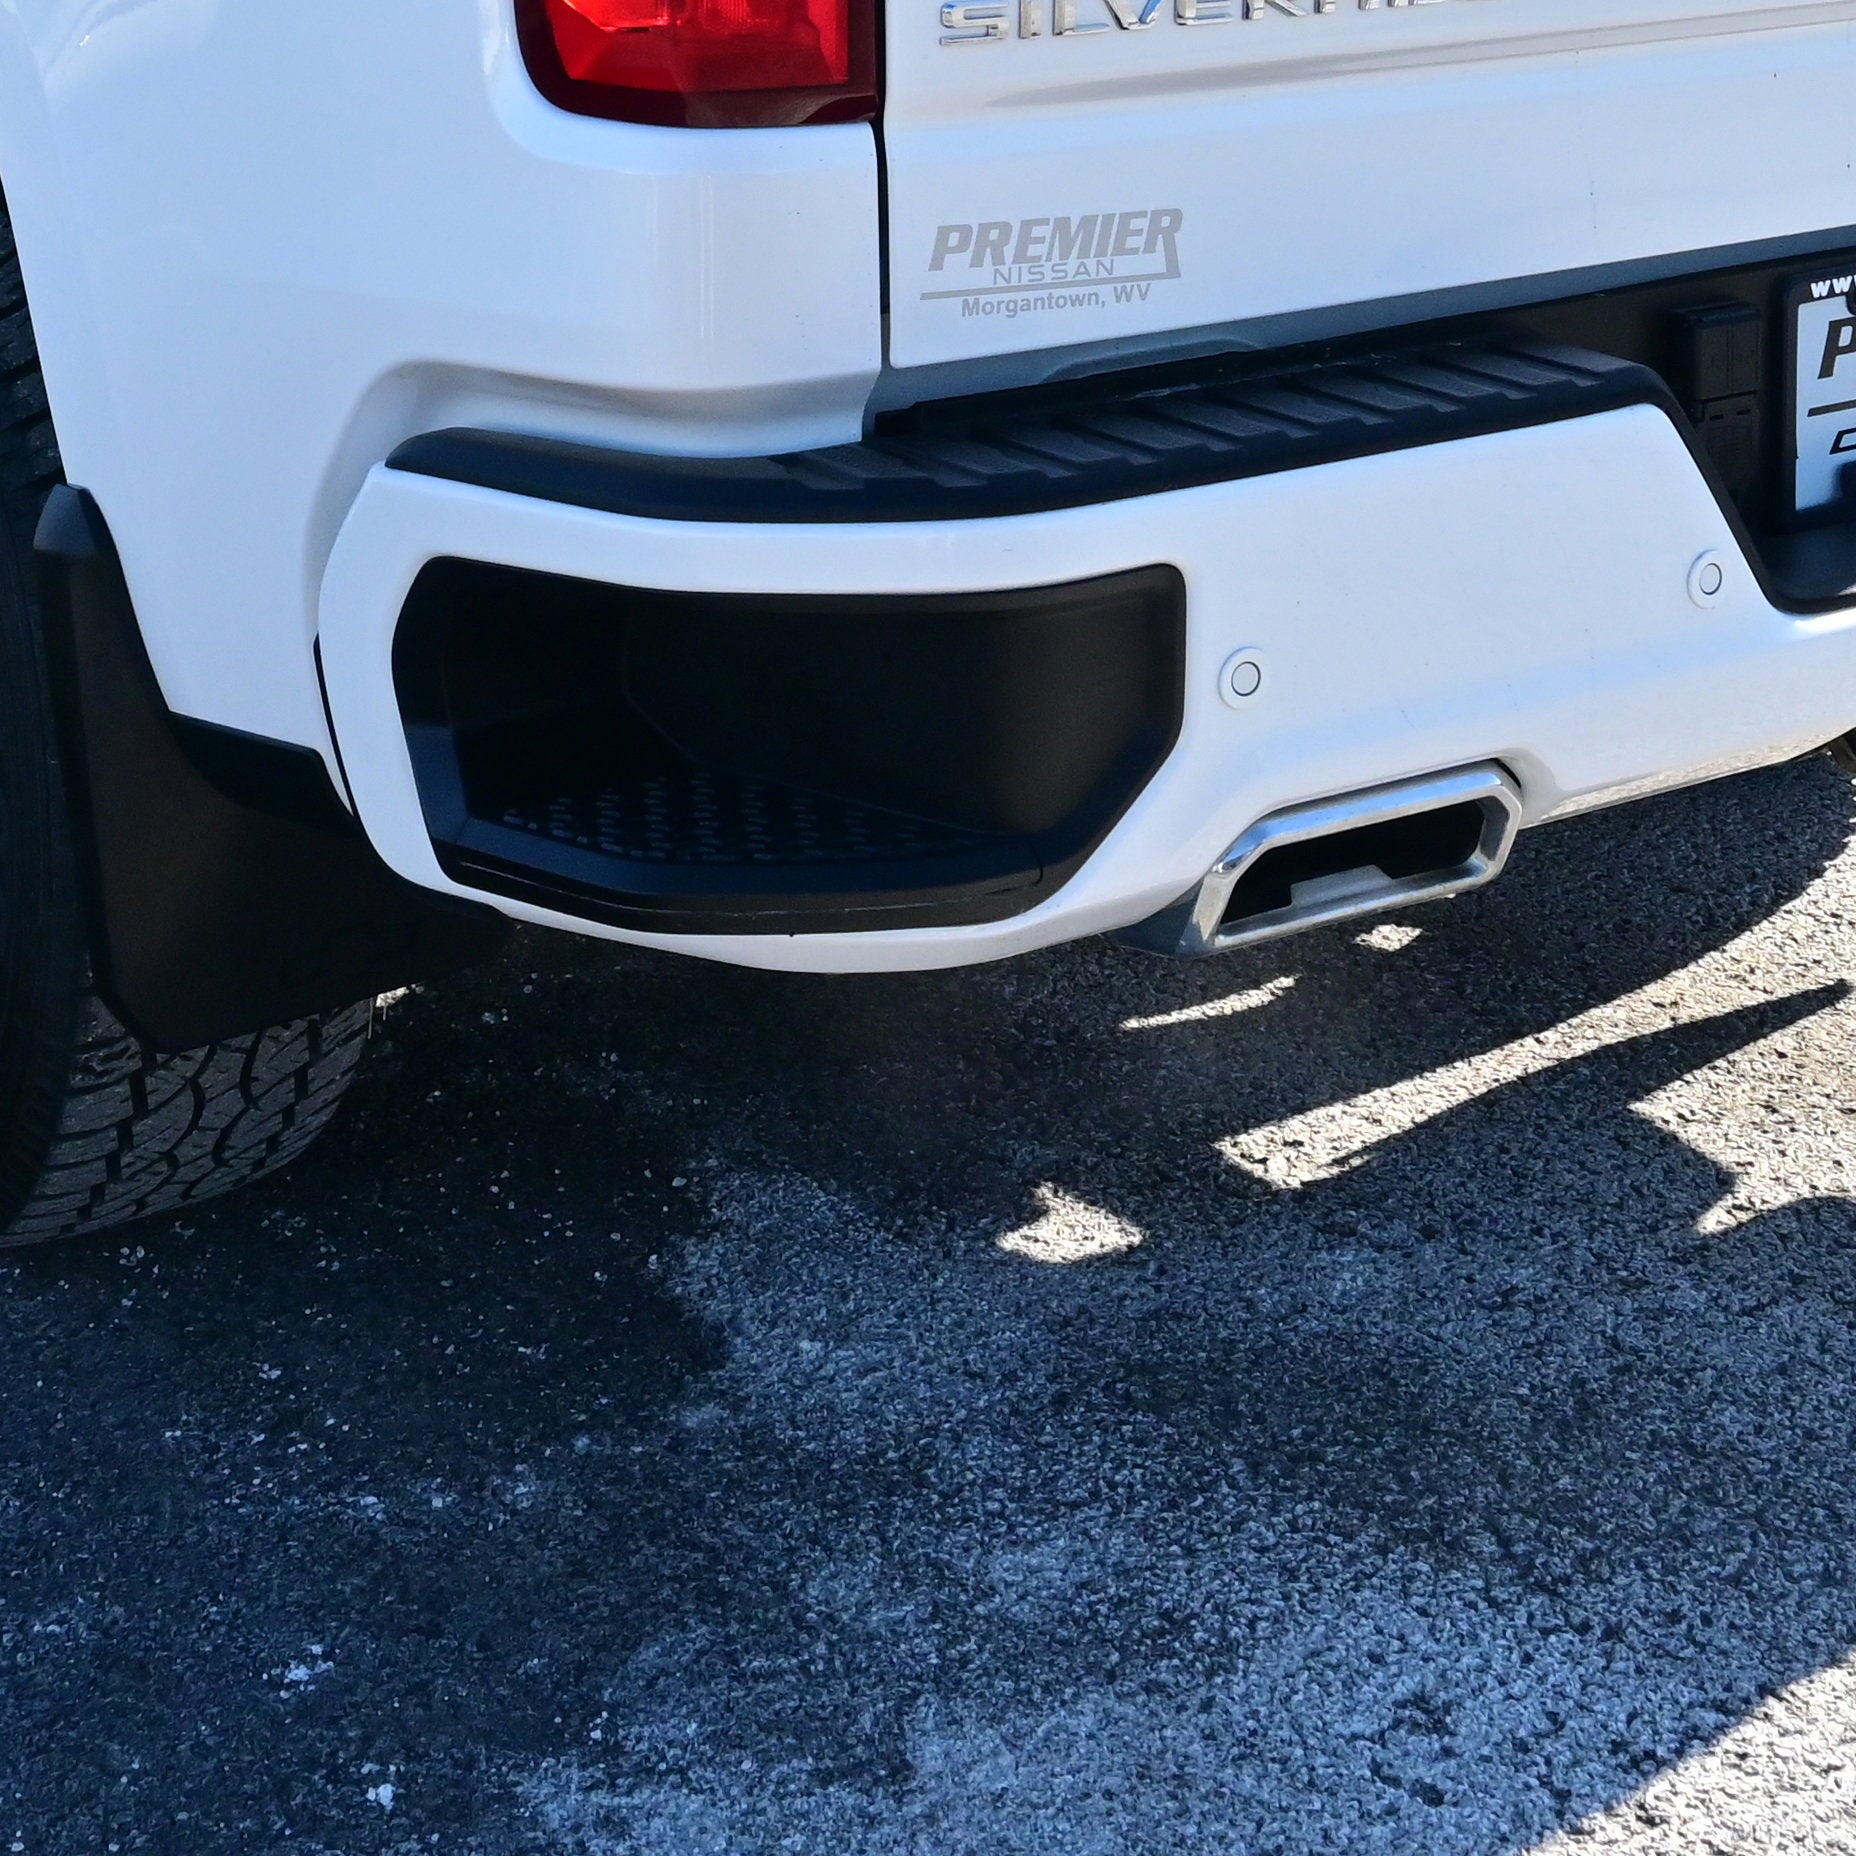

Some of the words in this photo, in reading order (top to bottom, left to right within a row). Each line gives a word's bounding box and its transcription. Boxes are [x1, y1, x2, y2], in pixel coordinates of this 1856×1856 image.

[928, 208, 1183, 278] PREMIER
[994, 259, 1115, 286] NISSAN
[962, 291, 1106, 318] Morgantown,
[1113, 283, 1152, 304] WV
